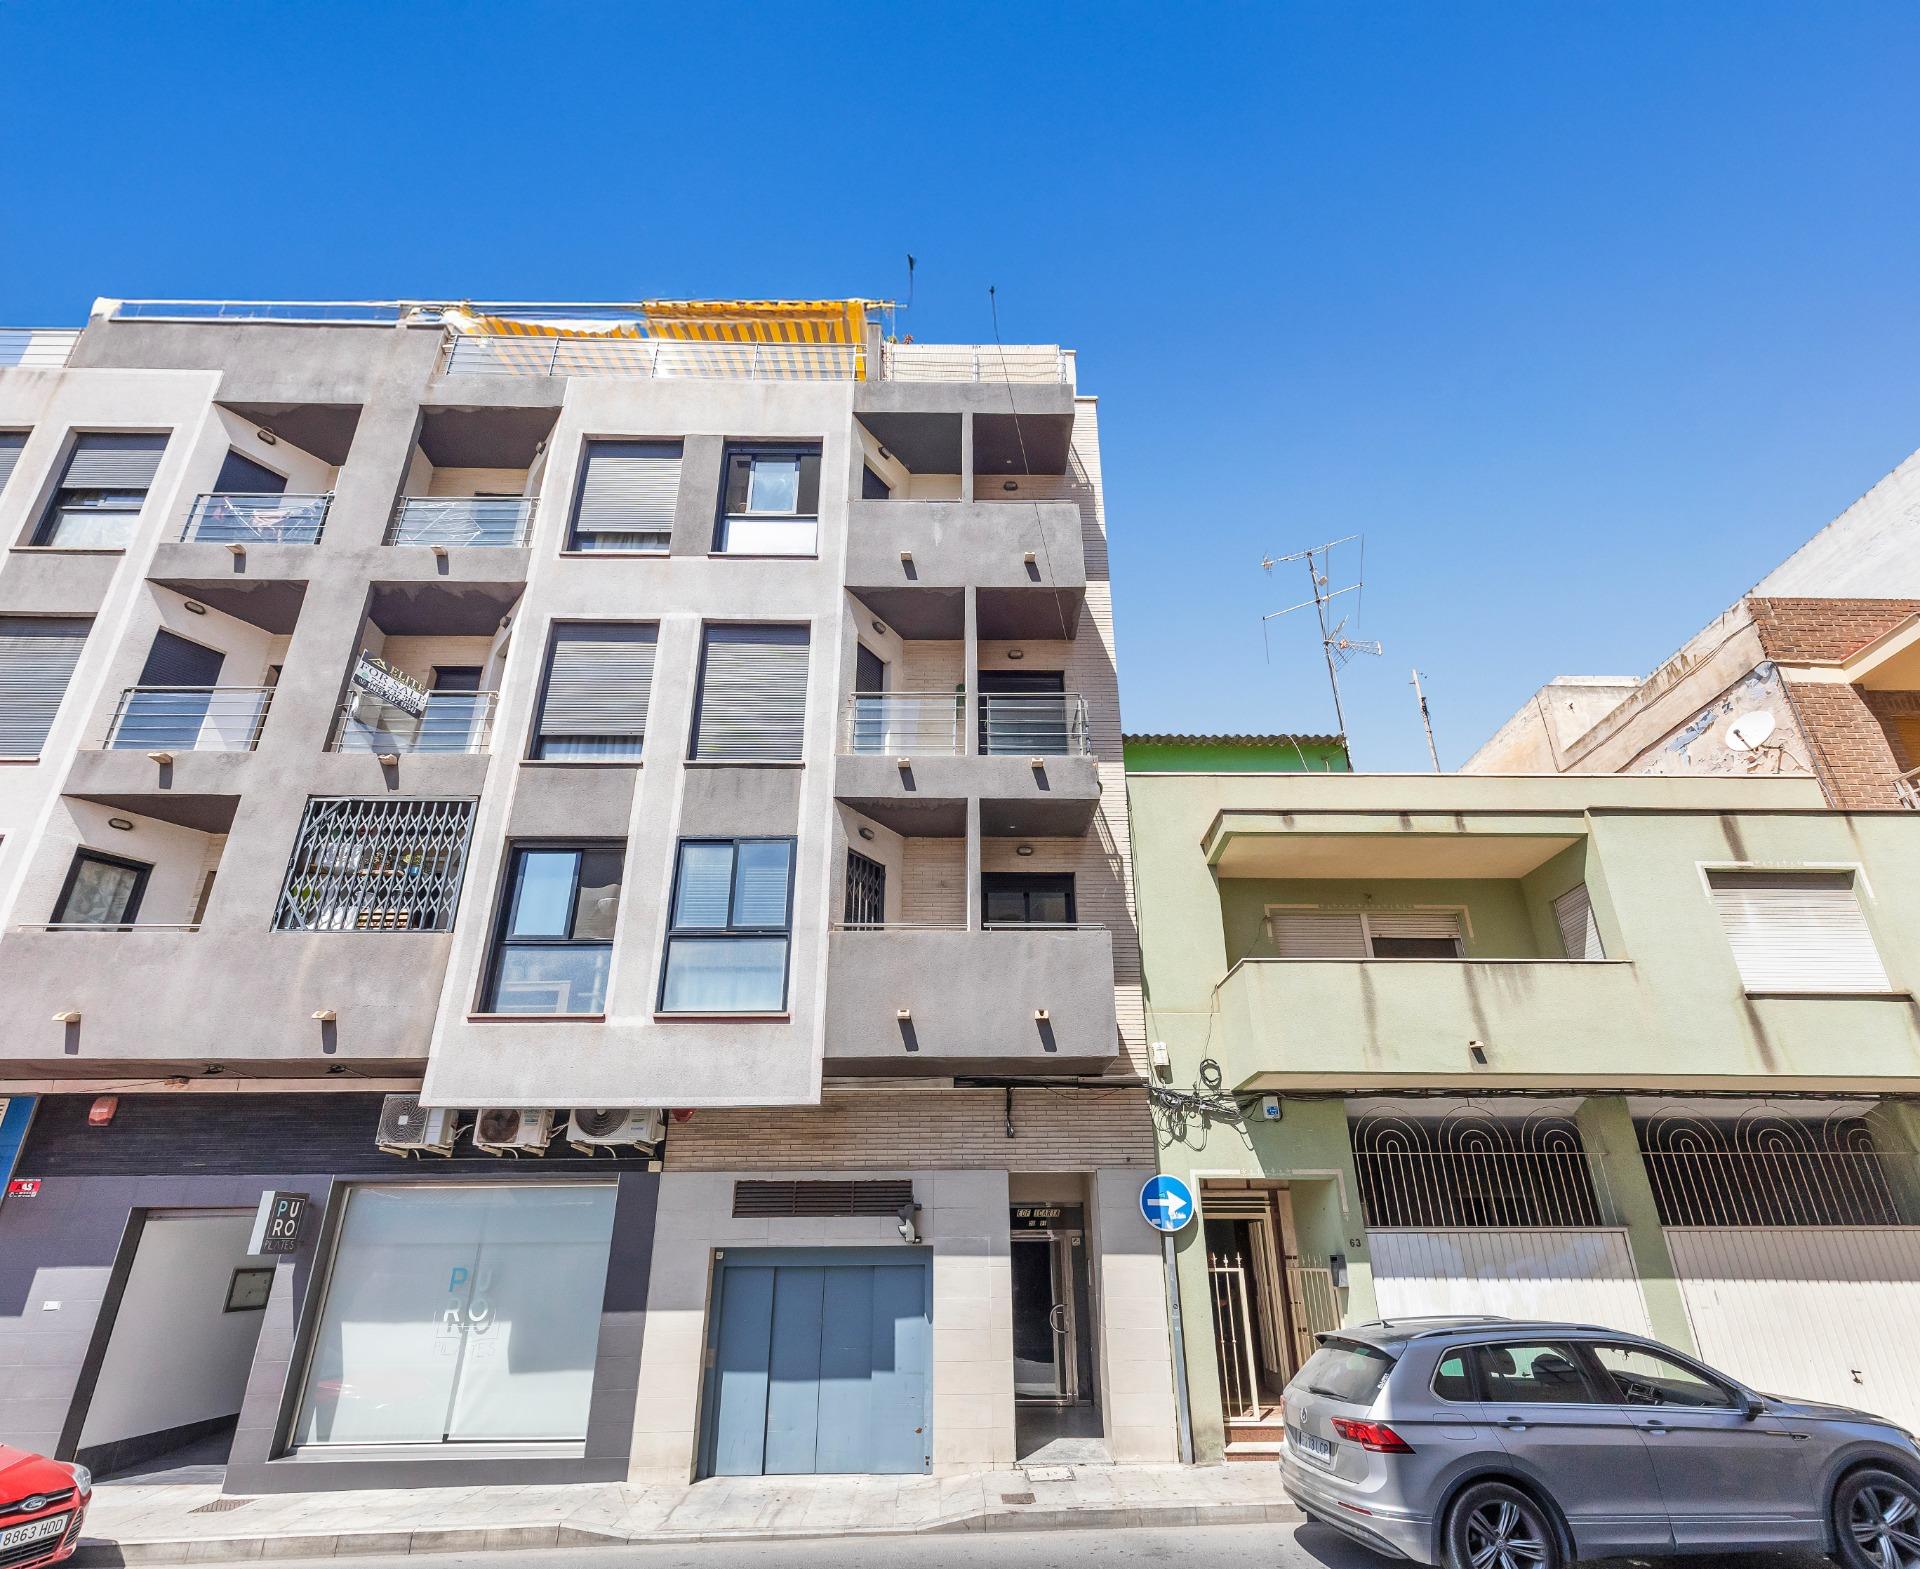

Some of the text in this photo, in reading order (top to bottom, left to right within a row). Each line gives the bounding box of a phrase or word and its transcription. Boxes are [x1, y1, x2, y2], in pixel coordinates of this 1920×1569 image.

[360, 662, 388, 684] FOR
[391, 681, 428, 704] SALE
[390, 666, 426, 693] ELITE
[277, 1200, 300, 1218] PU
[272, 1218, 296, 1237] RO
[1349, 1238, 1361, 1247] 63
[3, 1519, 63, 1546] 8863 HDD
